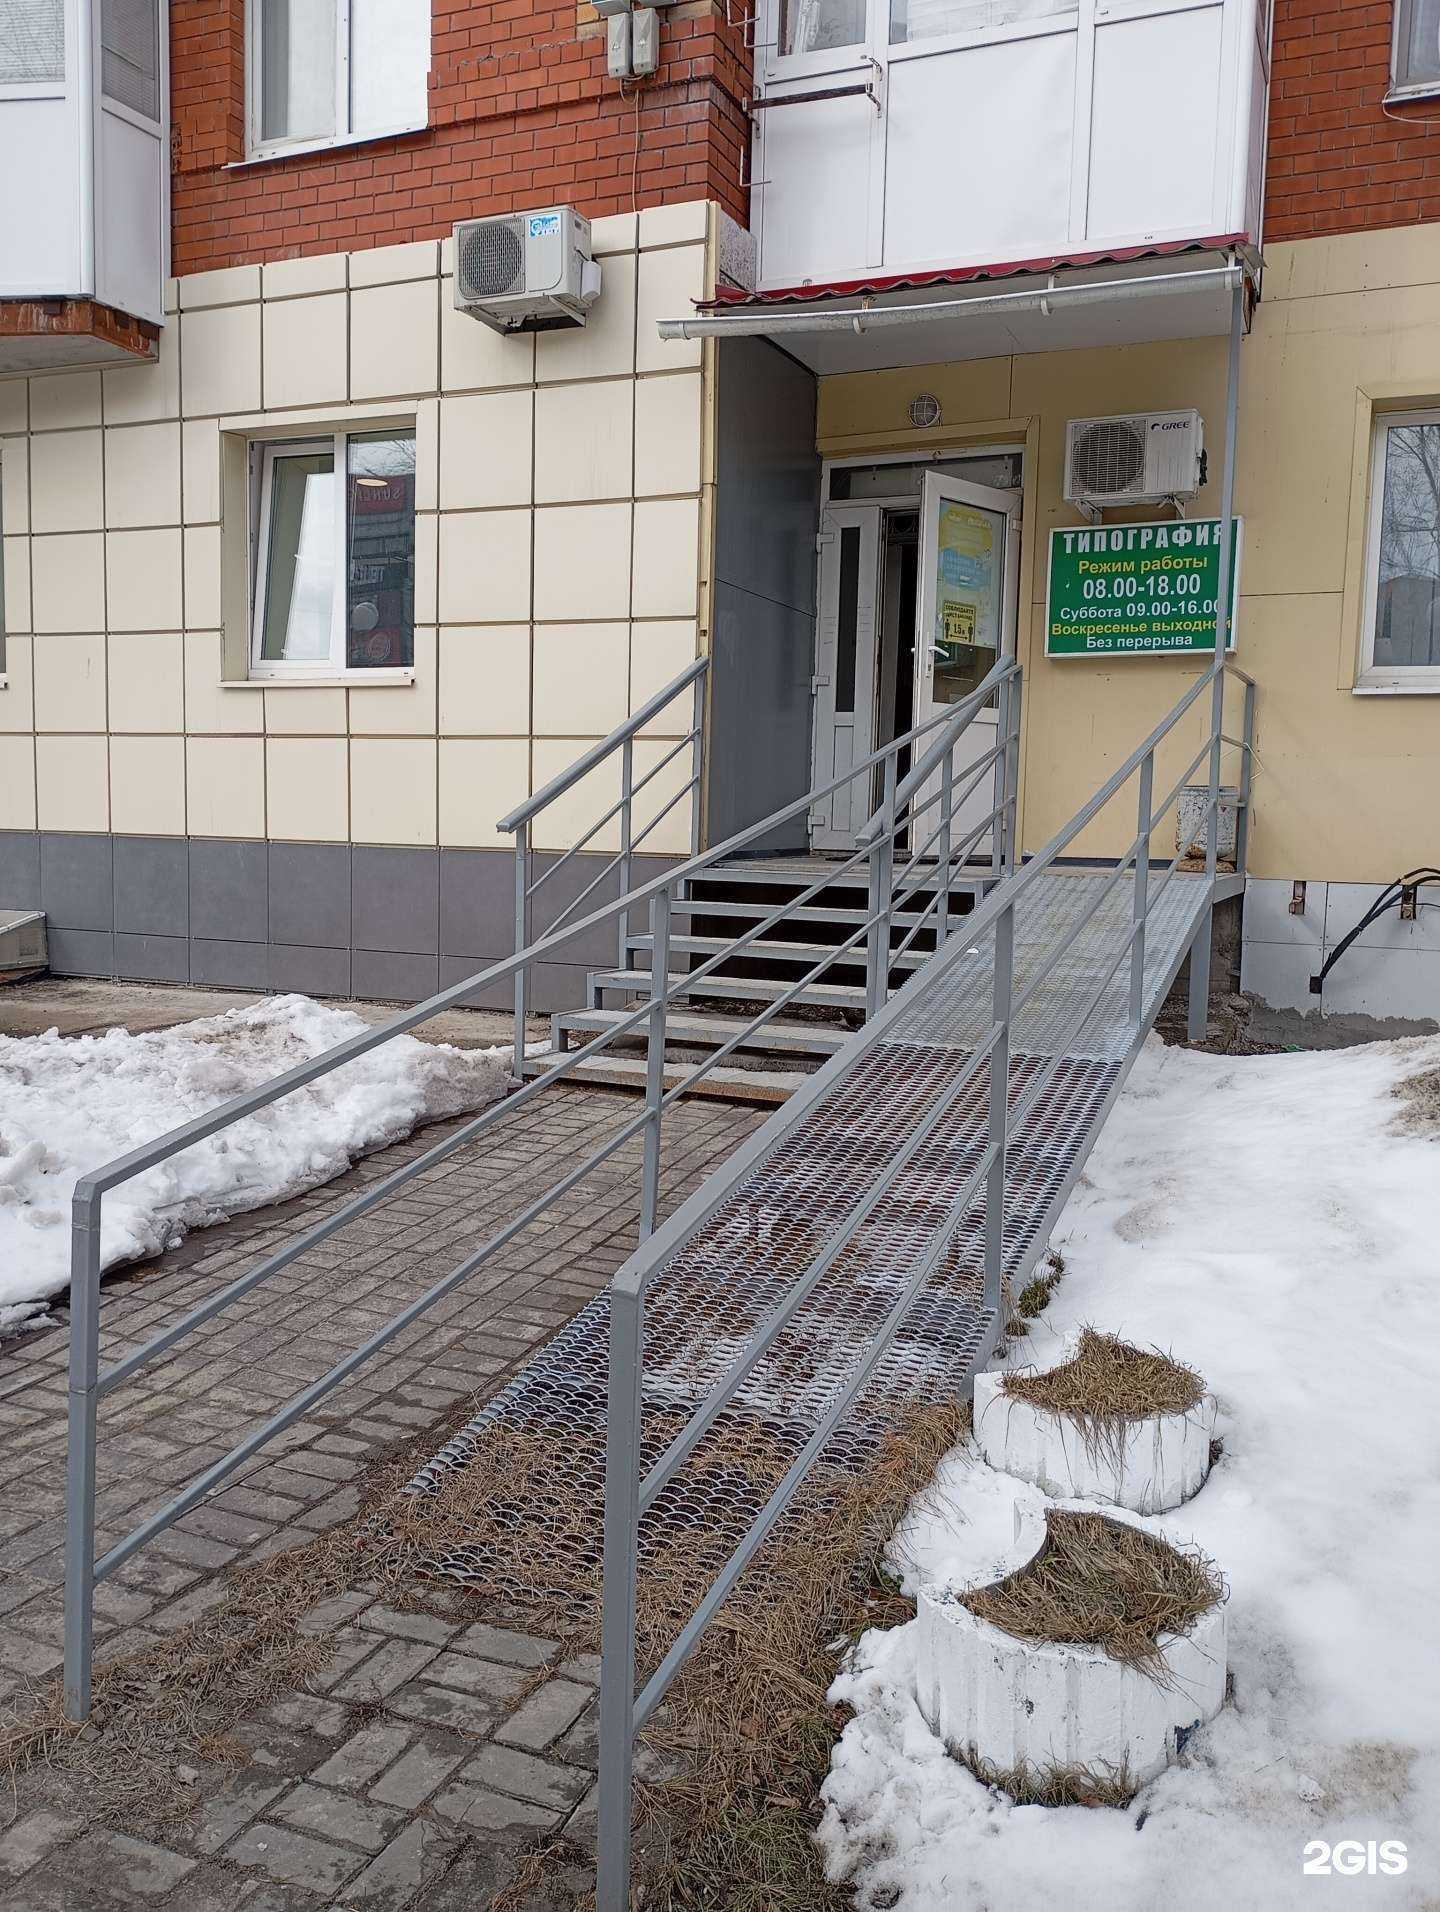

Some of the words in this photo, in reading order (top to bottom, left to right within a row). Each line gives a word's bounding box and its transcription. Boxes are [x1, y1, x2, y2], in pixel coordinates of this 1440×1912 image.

[1161, 421, 1190, 431] GREE
[1063, 524, 1222, 554] ТИПОГРАФИЯ
[1078, 559, 1135, 574] Режим
[1140, 556, 1208, 574] работы
[1083, 574, 1201, 599] 08.00-18.00
[1060, 607, 1122, 622] Суббота
[1052, 621, 1148, 636] Воскресенье
[1086, 636, 1113, 648] Без
[1117, 635, 1193, 649] перерыва
